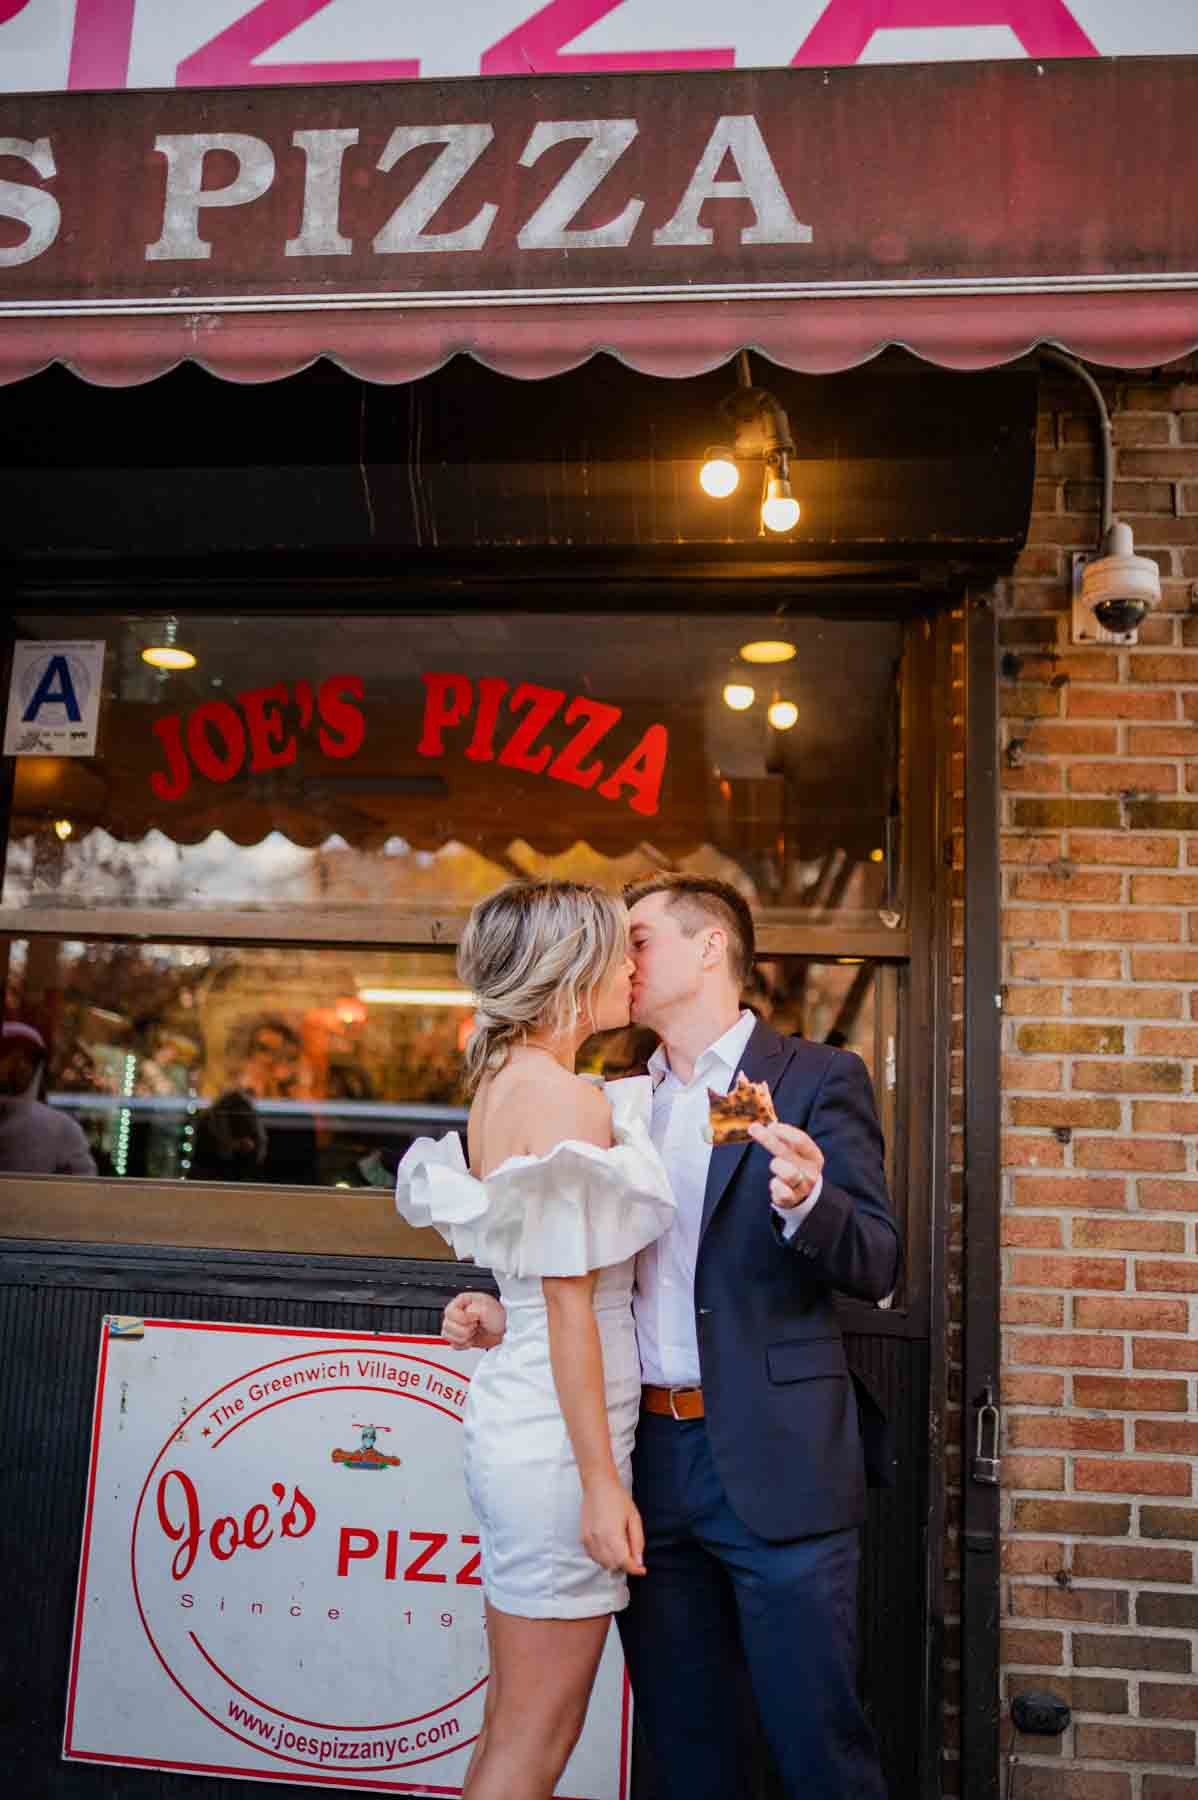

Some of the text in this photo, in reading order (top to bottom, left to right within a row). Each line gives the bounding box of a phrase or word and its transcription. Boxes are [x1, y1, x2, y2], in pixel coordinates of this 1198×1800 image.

[145, 114, 814, 261] PIZZA
[22, 654, 82, 722] A
[151, 672, 669, 817] JOE'S PIZZA
[209, 1397, 246, 1427] The
[248, 1360, 350, 1402] Greenwich
[356, 1359, 421, 1388] Village
[156, 1470, 317, 1581] Joe's
[180, 1593, 341, 1620] Since
[227, 1699, 461, 1762] www.joespizzanyc.com
